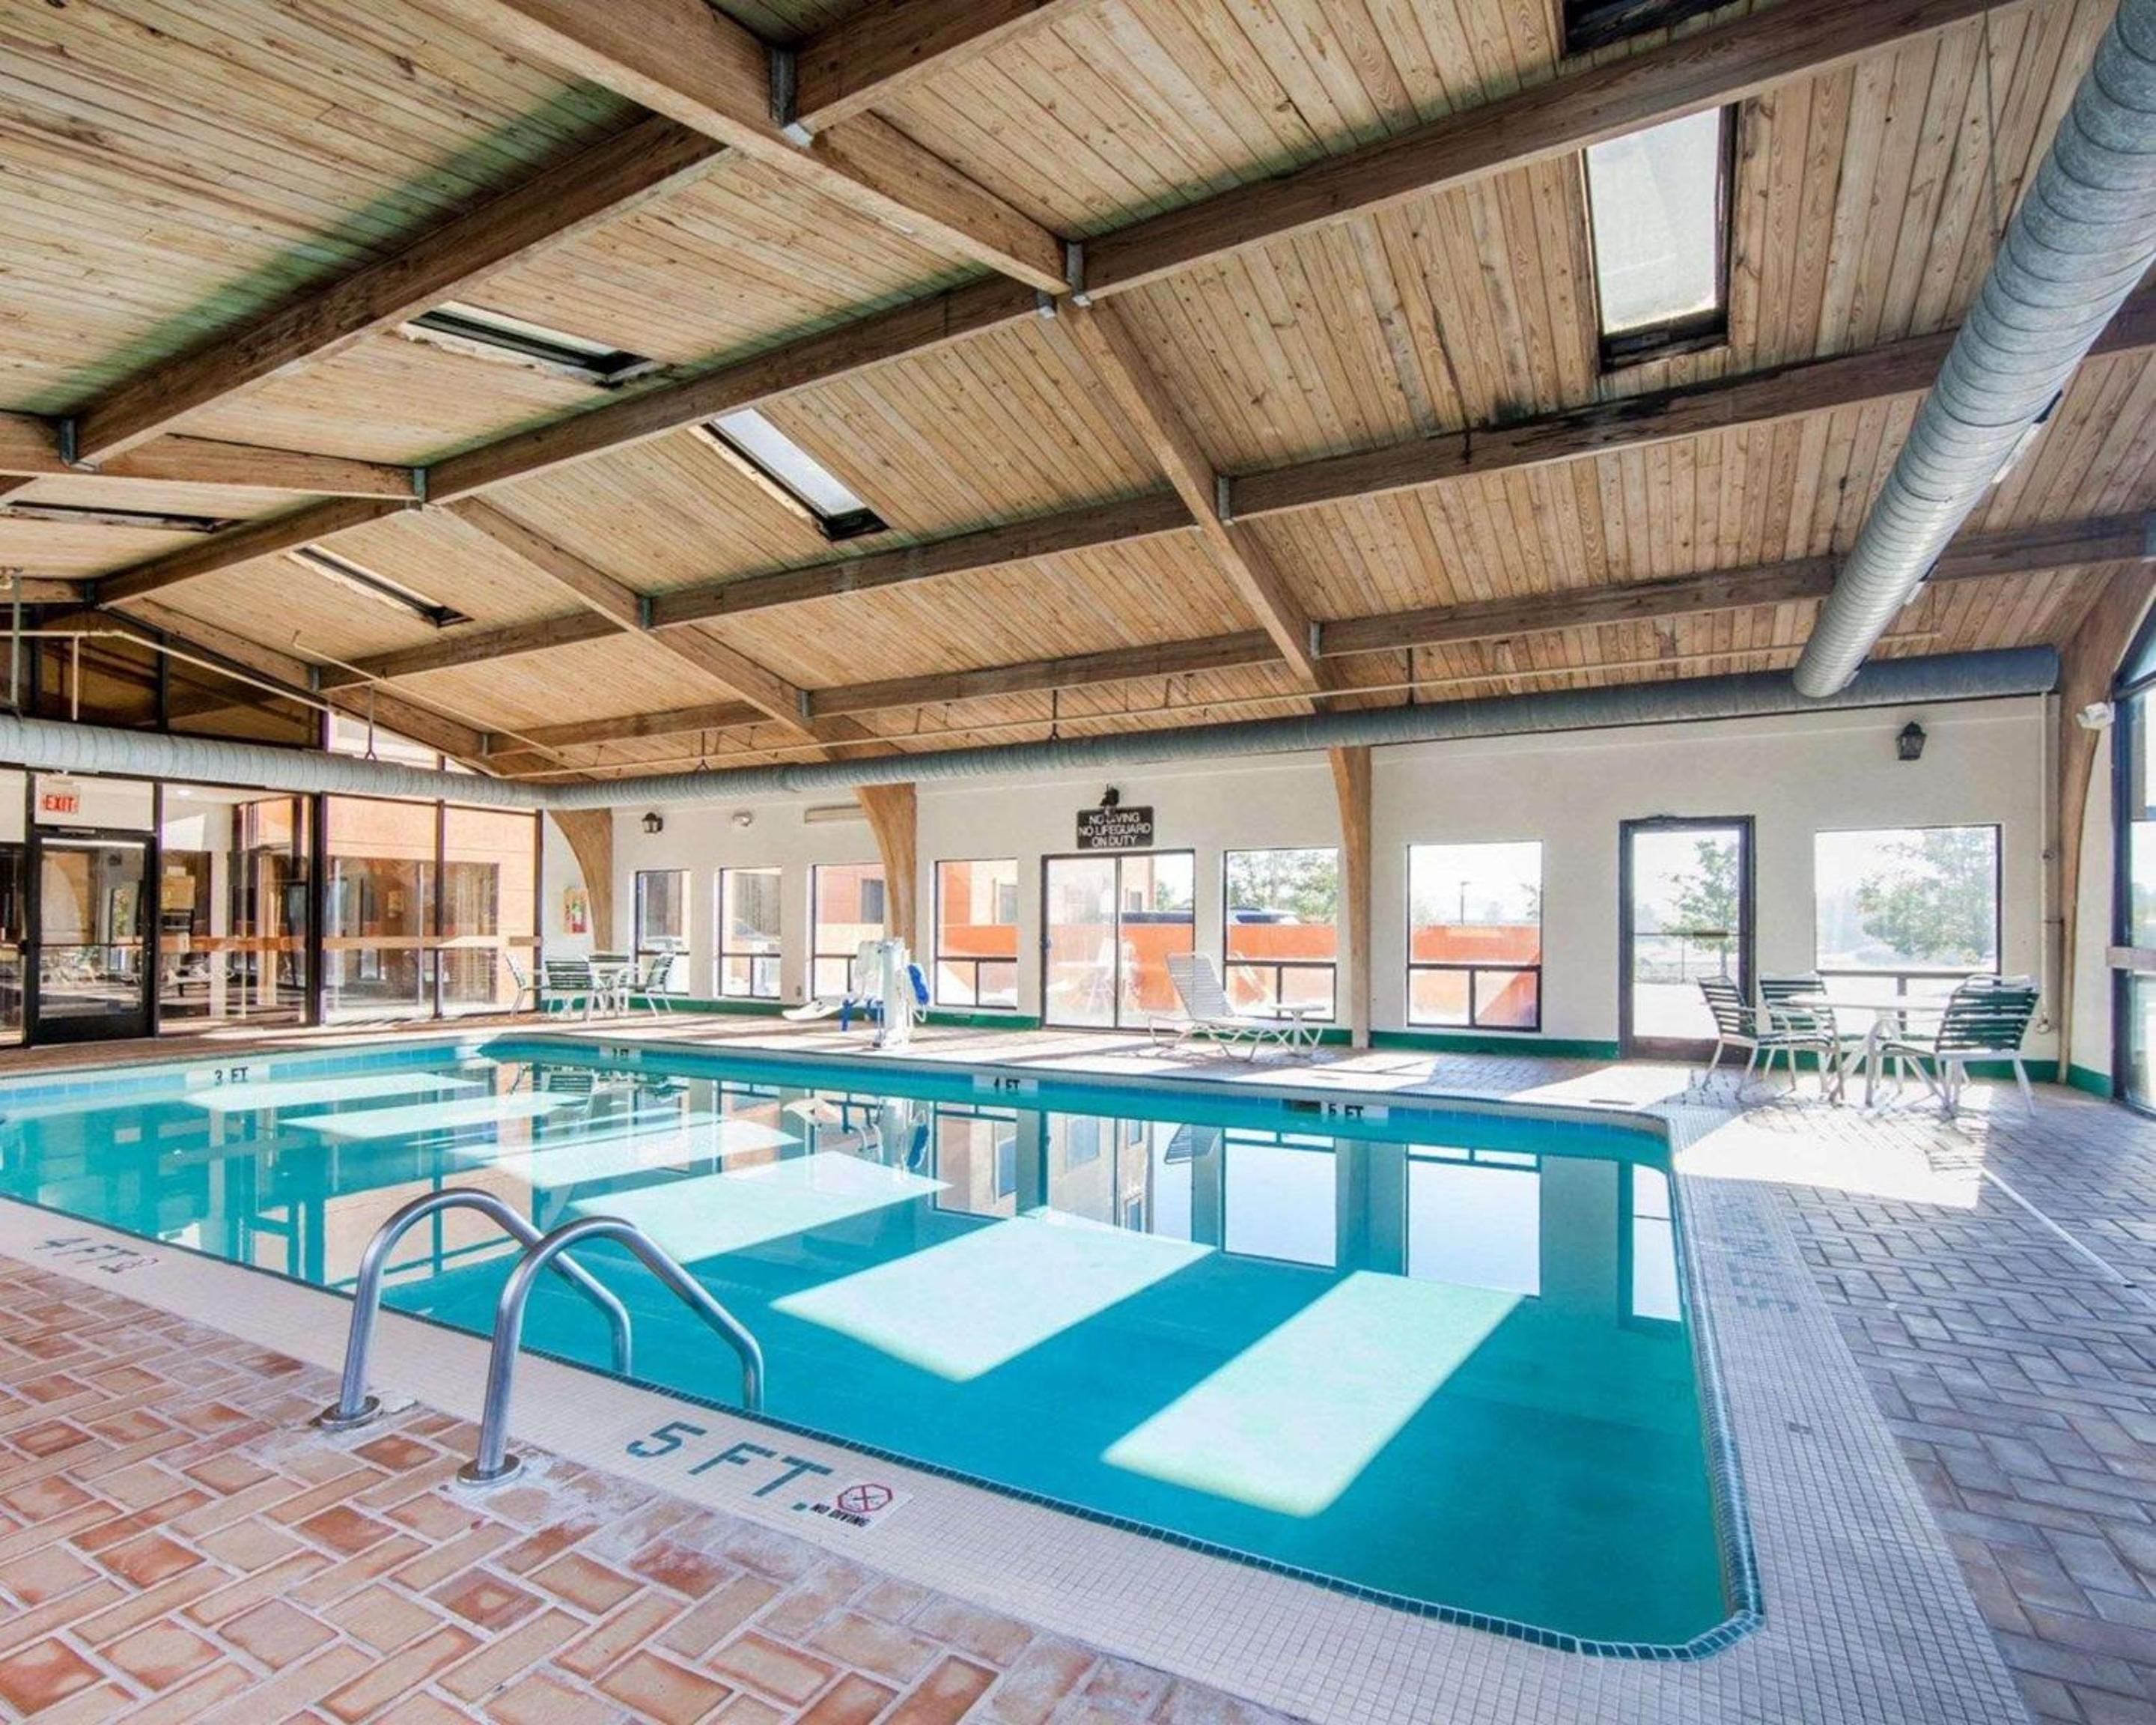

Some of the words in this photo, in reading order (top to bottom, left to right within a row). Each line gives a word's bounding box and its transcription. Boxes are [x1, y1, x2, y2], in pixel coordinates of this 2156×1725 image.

[46, 794, 73, 812] EXIT
[1089, 815, 1104, 824] NO
[1079, 827, 1094, 836] NO
[1095, 823, 1151, 836] LIFEGUARD
[1092, 836, 1106, 847] ON
[1109, 835, 1137, 845] DUTY
[214, 1069, 223, 1086] 3
[231, 1066, 249, 1083] FT
[626, 1421, 707, 1458] 5
